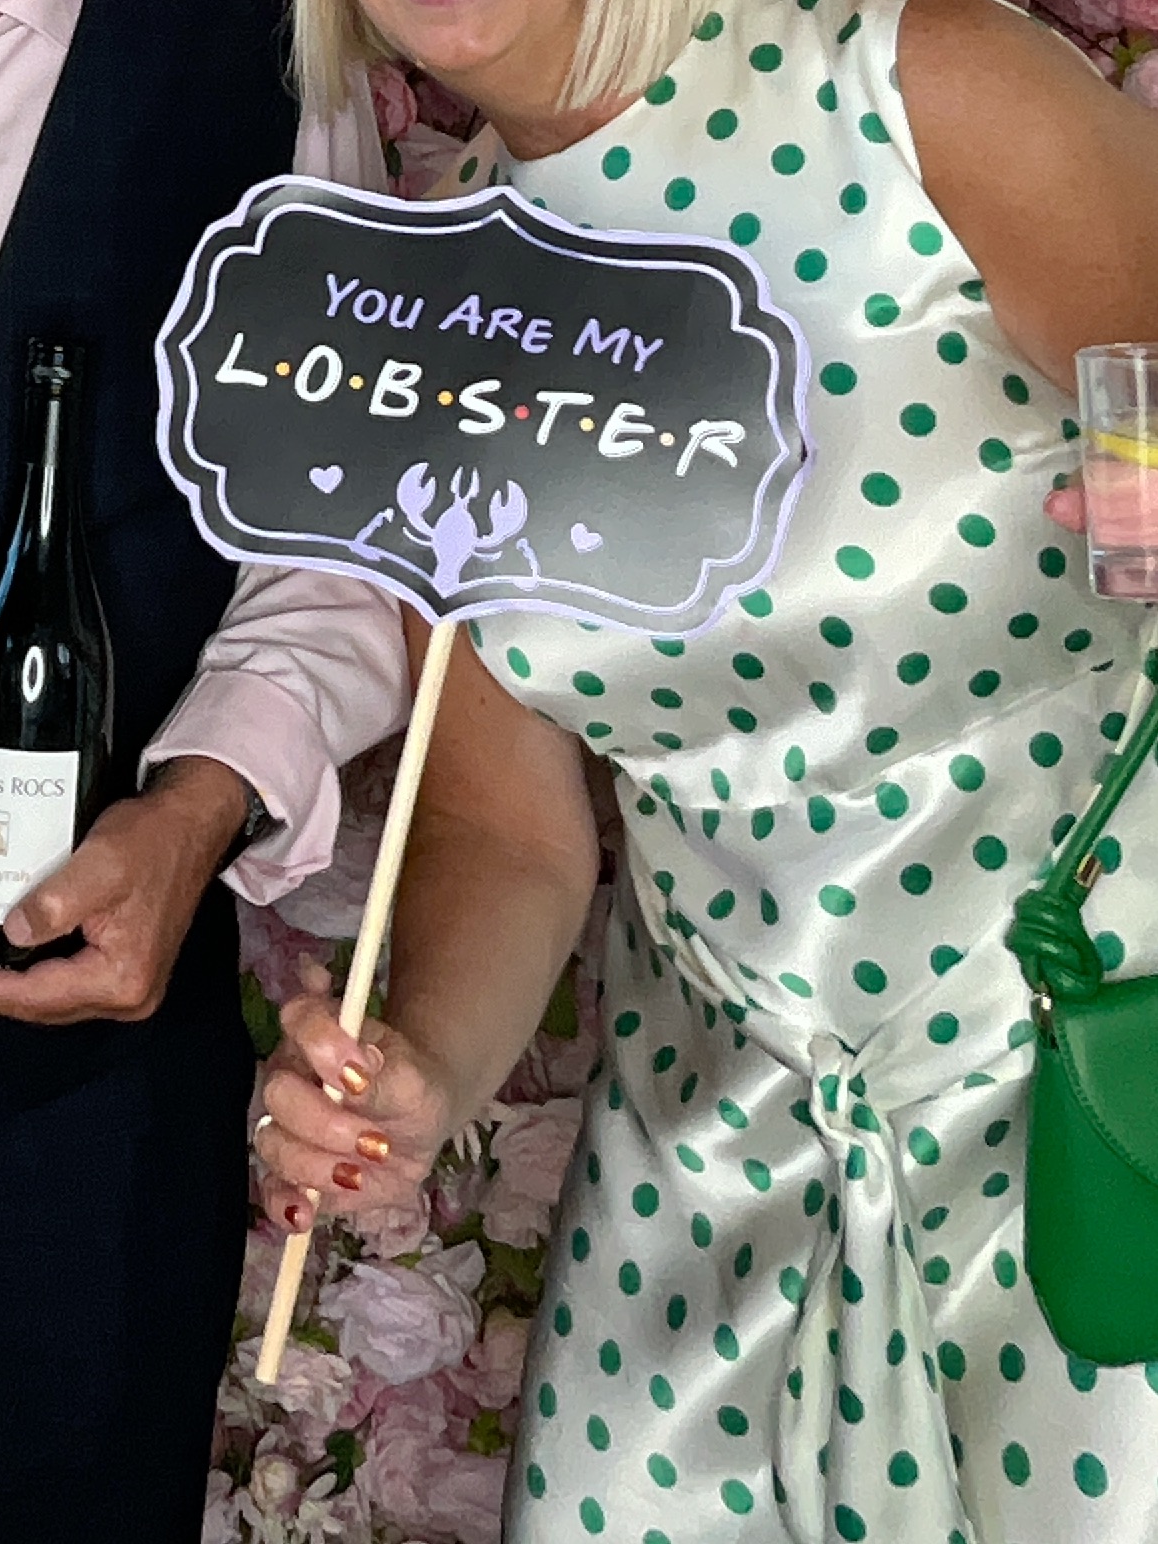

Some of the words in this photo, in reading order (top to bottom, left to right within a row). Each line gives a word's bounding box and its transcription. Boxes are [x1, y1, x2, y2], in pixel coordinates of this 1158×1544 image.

[324, 273, 425, 327] YOU
[438, 294, 555, 355] ARE
[572, 317, 665, 373] MY
[11, 776, 65, 797] ROCS
